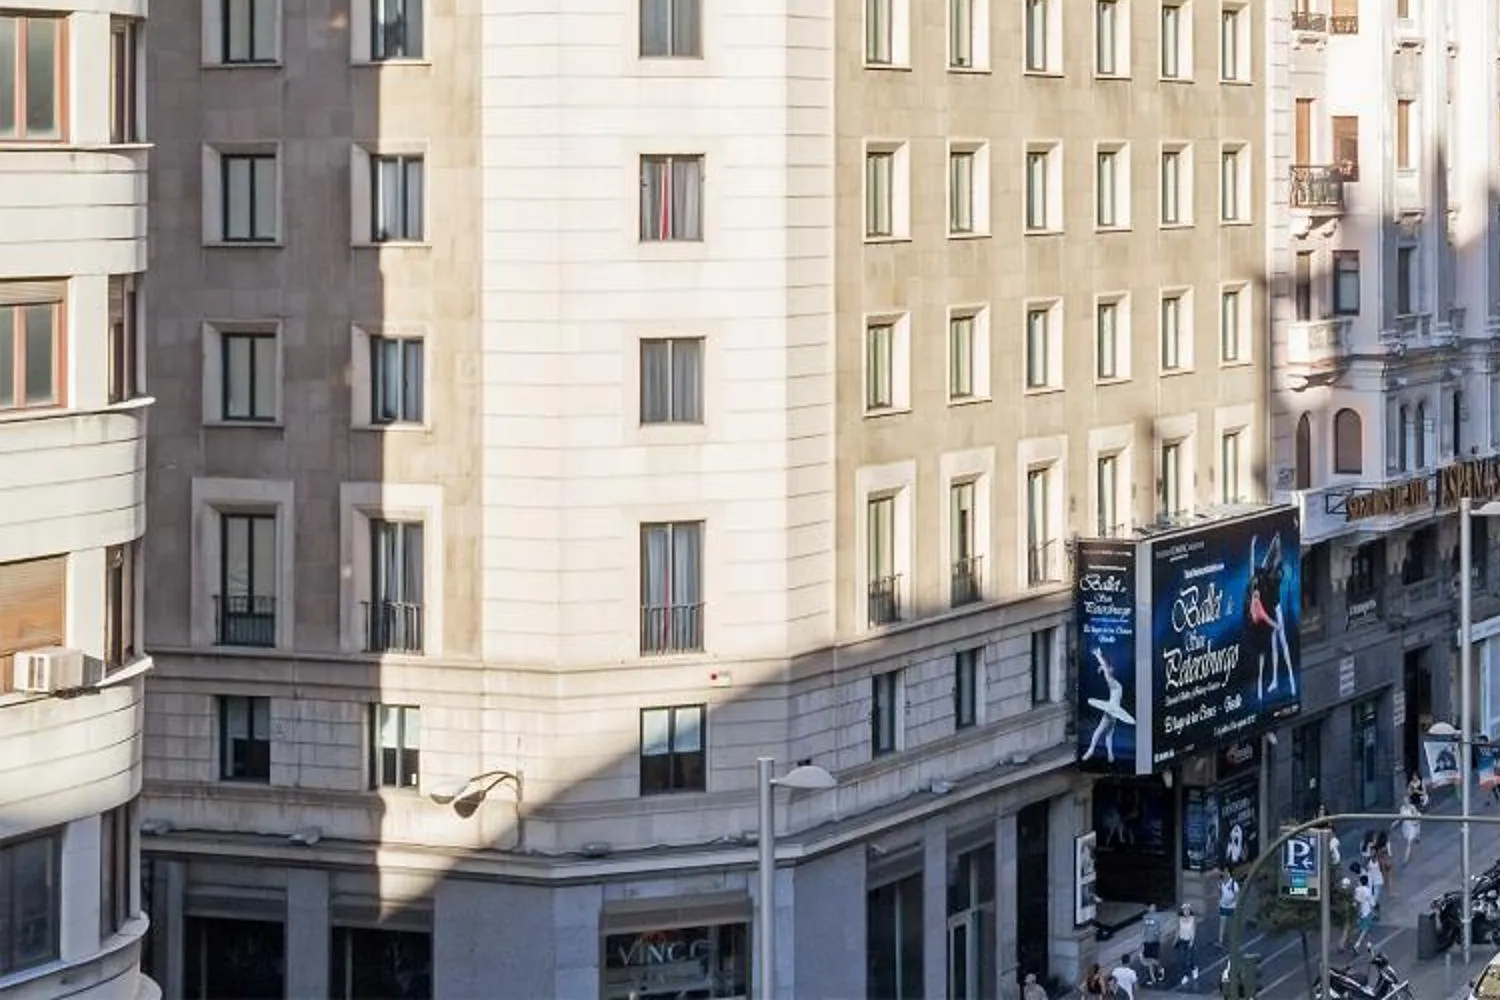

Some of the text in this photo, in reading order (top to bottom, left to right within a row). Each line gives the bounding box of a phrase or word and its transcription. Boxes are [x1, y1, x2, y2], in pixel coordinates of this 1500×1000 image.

[1171, 583, 1224, 632] Ballet
[1163, 638, 1241, 690] Petersburgo
[1287, 839, 1310, 866] P
[617, 937, 714, 967] VINCC
